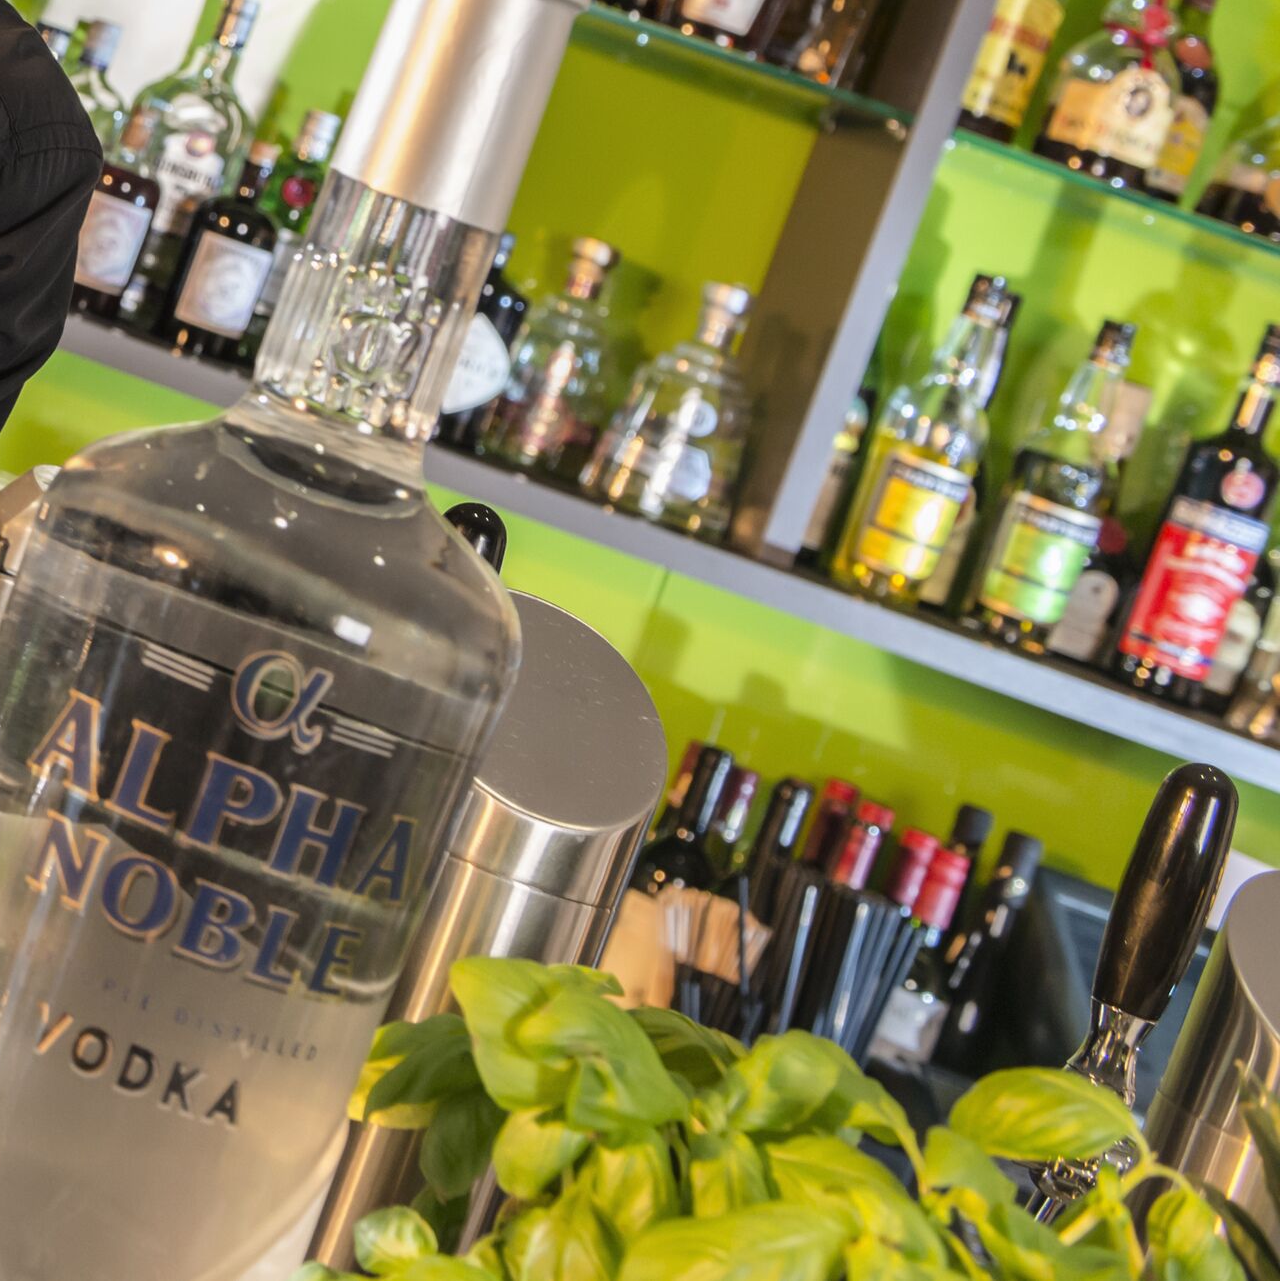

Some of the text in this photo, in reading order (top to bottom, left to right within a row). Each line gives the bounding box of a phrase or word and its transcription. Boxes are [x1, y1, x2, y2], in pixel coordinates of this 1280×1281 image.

[27, 688, 418, 908] ALPHA
[26, 811, 364, 1003] NOBLE
[33, 1000, 239, 1125] VODKA
